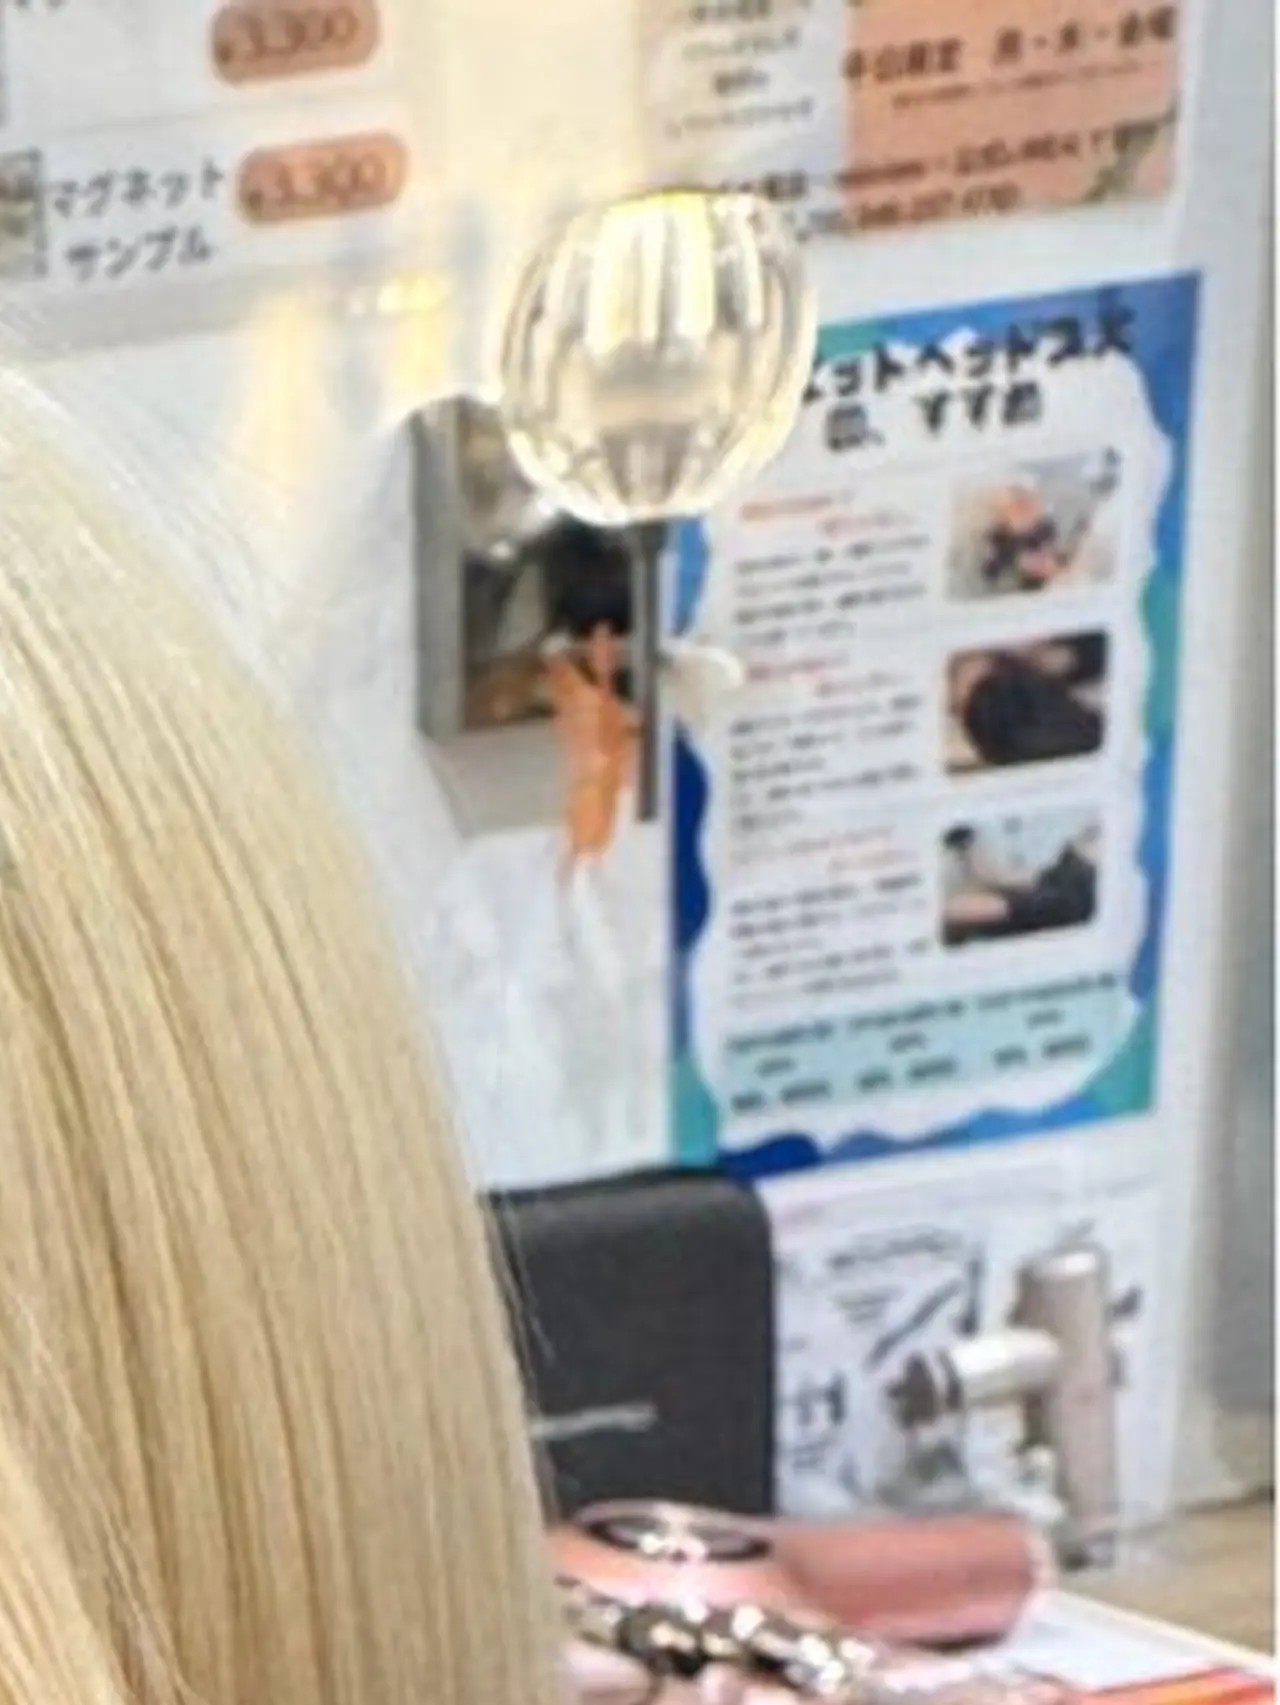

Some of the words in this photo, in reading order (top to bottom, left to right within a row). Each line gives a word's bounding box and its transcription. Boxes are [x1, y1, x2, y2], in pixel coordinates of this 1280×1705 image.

[51, 157, 226, 218] マグネット
[64, 225, 216, 282] サンプル
